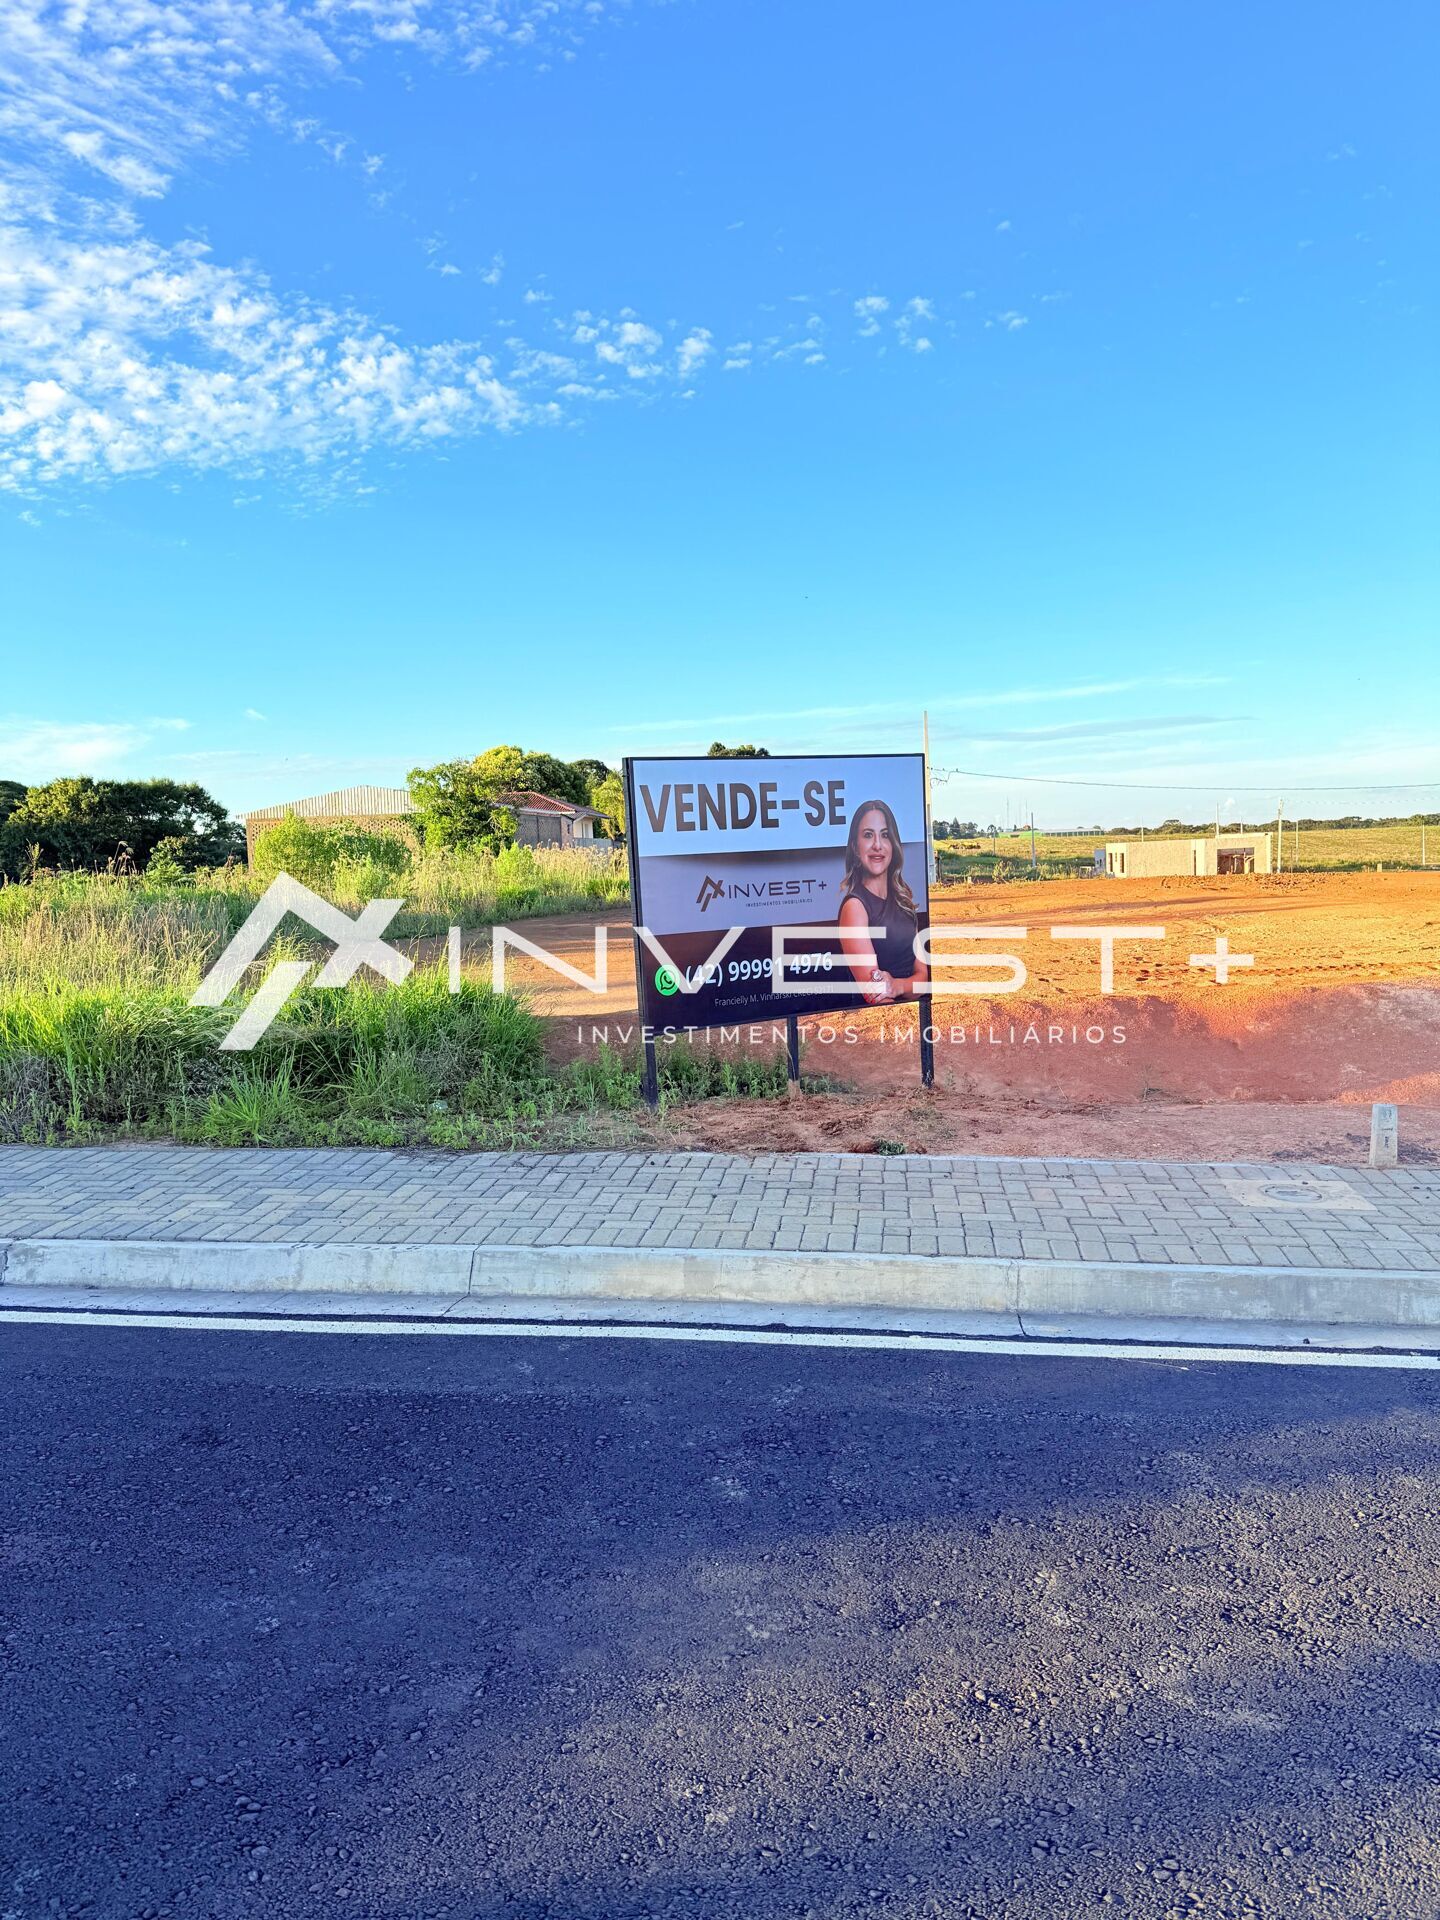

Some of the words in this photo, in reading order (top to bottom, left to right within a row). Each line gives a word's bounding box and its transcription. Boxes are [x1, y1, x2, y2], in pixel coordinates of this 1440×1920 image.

[639, 780, 847, 832] VENDE-SE
[686, 963, 723, 990] (42)
[728, 957, 783, 982] 99991
[790, 952, 833, 975] 4976
[750, 994, 759, 1003] M.
